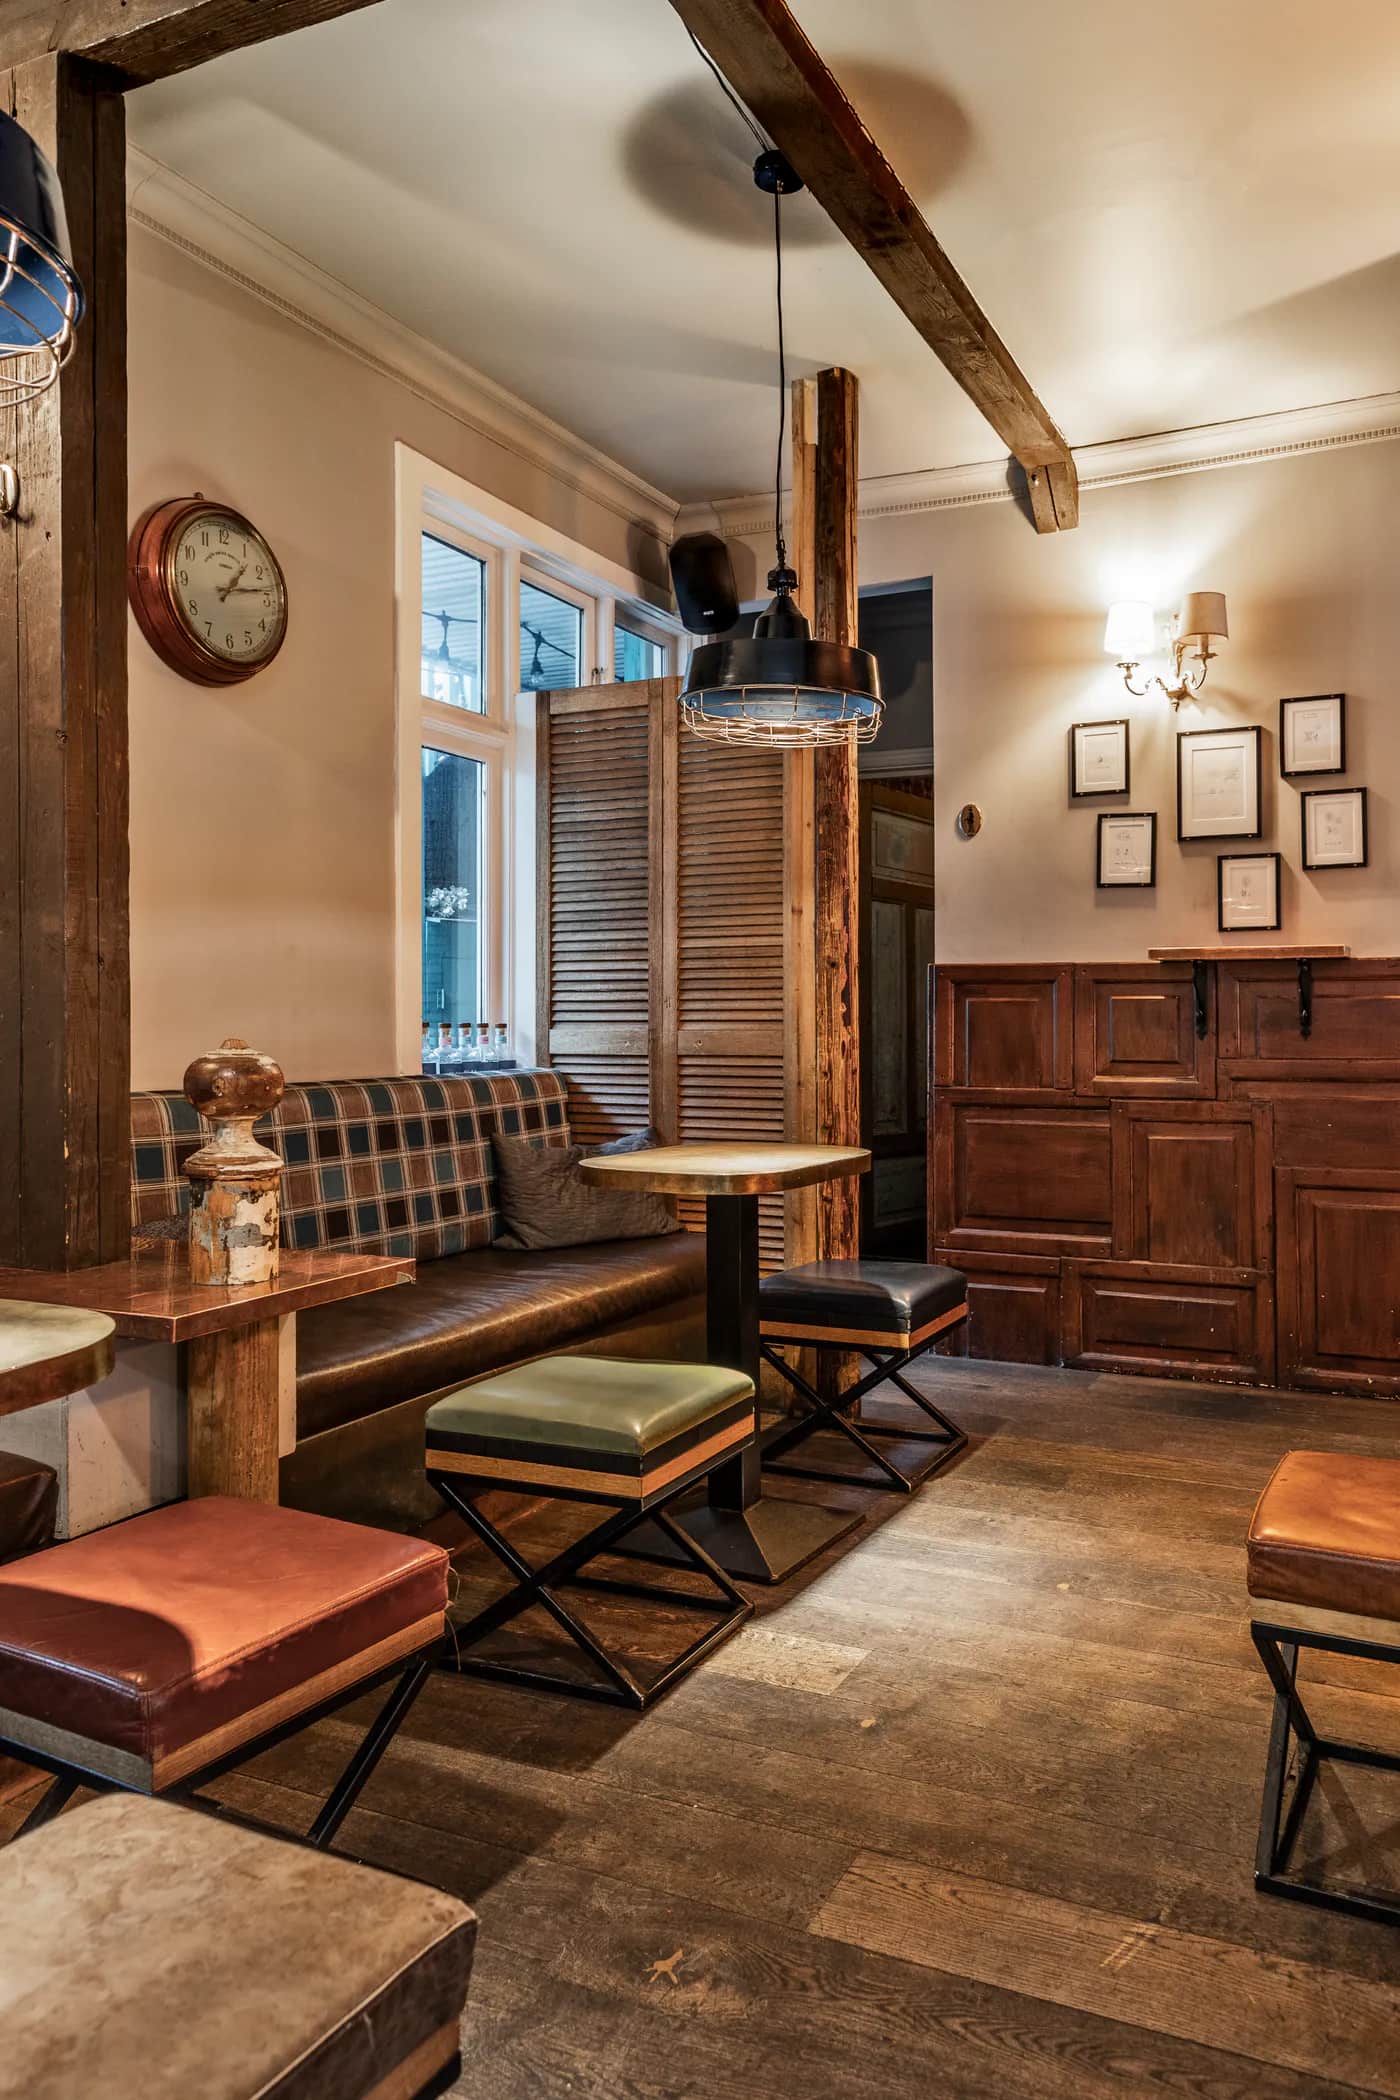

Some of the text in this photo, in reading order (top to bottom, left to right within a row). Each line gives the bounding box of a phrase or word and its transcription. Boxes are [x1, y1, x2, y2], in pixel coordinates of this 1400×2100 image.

[201, 531, 209, 547] 11
[219, 528, 230, 544] 12
[184, 544, 196, 561] 10
[243, 543, 247, 558] 1
[180, 569, 189, 585] 9
[255, 565, 263, 580] 2
[189, 600, 198, 615] 8
[204, 621, 213, 637] 7
[258, 618, 266, 632] 4
[225, 633, 234, 649] 6
[244, 630, 253, 646] 5
